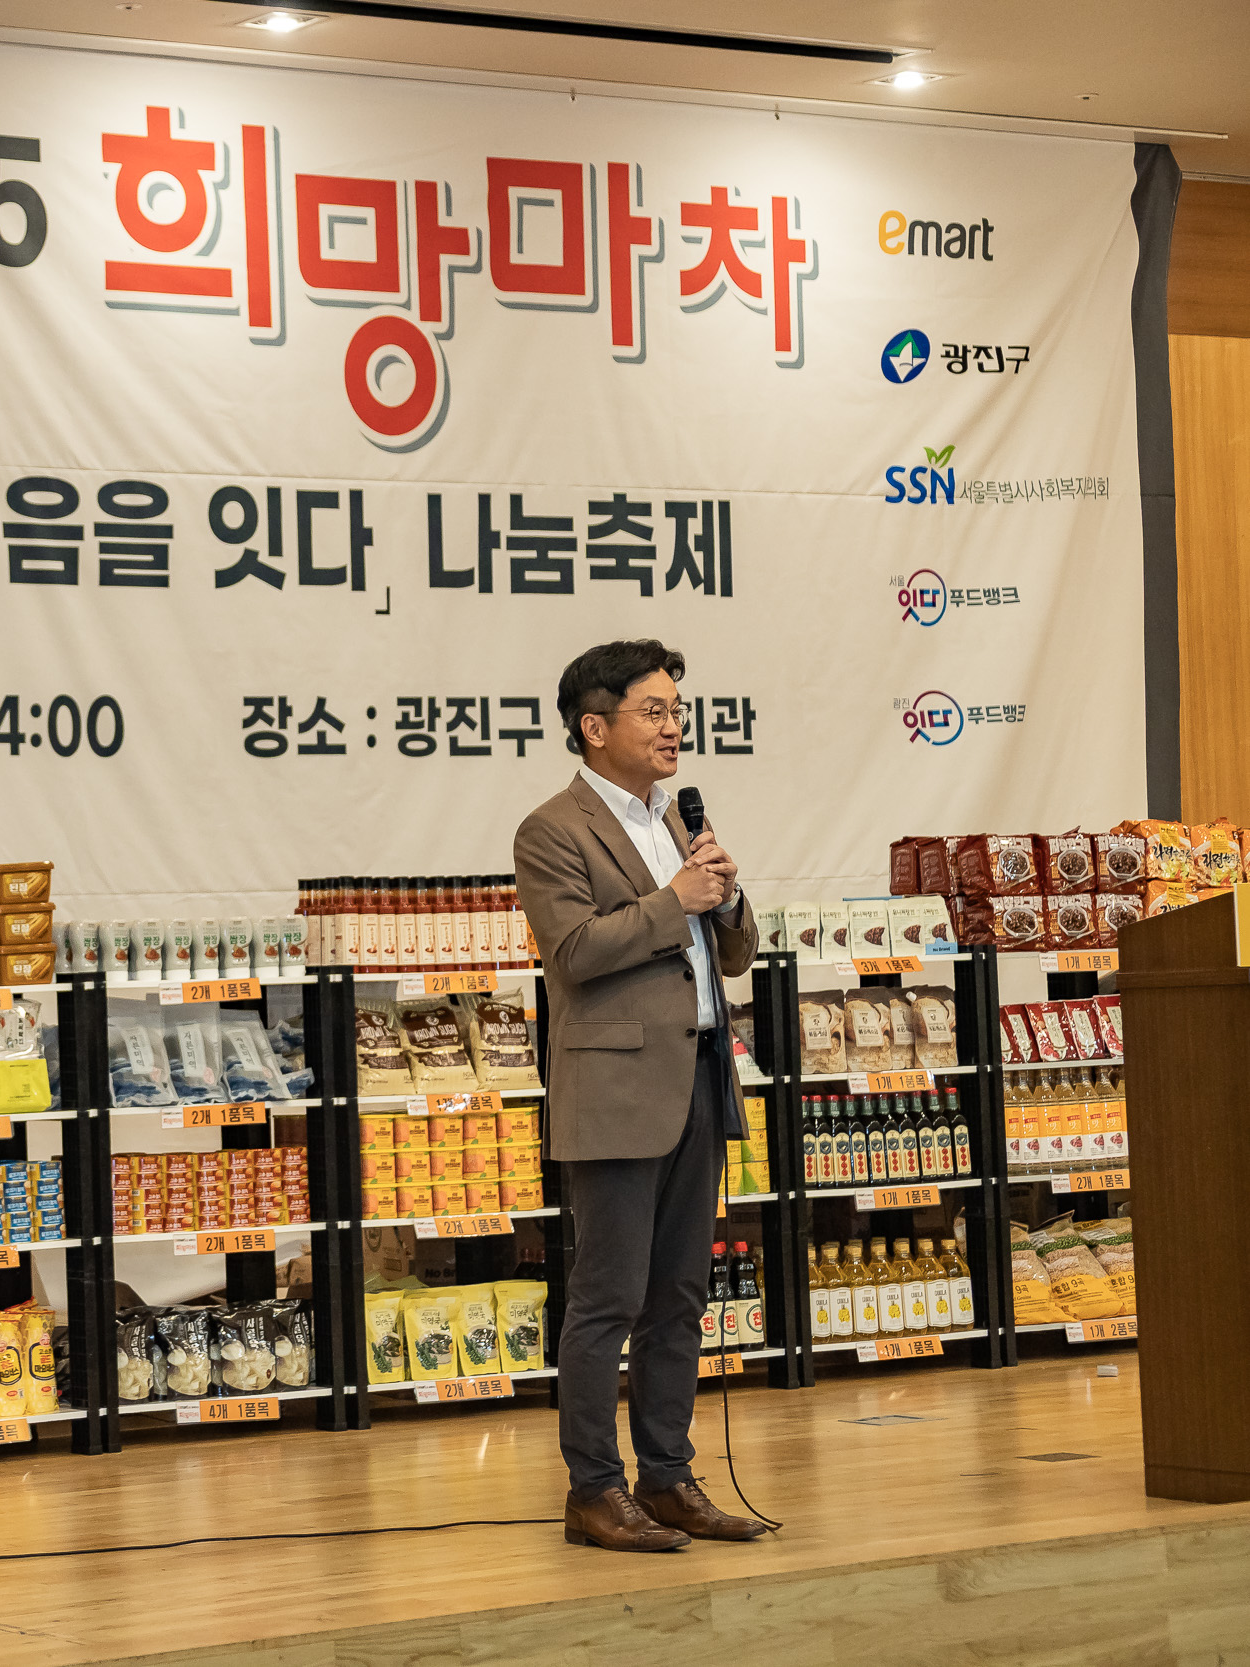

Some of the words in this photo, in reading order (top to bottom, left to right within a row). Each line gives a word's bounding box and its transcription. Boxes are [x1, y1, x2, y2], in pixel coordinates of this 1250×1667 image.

[879, 210, 994, 262] emart
[101, 104, 815, 450] 희망마차
[940, 342, 1030, 375] 광진구
[885, 465, 956, 504] SSN
[427, 492, 734, 598] 나눔축제
[950, 586, 1020, 607] 푸드뱅크
[242, 696, 347, 758] 장소
[395, 696, 544, 757] 광진구
[861, 959, 879, 973] 3개
[887, 957, 913, 971] 1품목
[1065, 957, 1080, 969] 1개
[1087, 955, 1111, 967] 1품목
[192, 986, 210, 999] 2개
[221, 983, 250, 997] 1품목
[433, 978, 450, 992] 2개
[460, 975, 489, 990] 1품목
[876, 1077, 892, 1090] 1개
[899, 1075, 925, 1088] 1품목
[192, 1110, 210, 1124] 2개
[222, 1107, 254, 1122] 1품목
[1077, 1177, 1091, 1189] 2개
[1100, 1175, 1123, 1187] 1품목
[882, 1192, 897, 1205] 1개
[906, 1190, 931, 1203] 1품목
[444, 1221, 463, 1235] 2개
[471, 1218, 502, 1233] 1품목
[206, 1237, 224, 1251] 2개
[235, 1235, 265, 1249] 1품목
[1091, 1325, 1103, 1337] 1개
[1111, 1322, 1136, 1335] 2품목
[885, 1344, 901, 1356] 1개
[909, 1341, 934, 1354] 1품목
[445, 1384, 464, 1398] 2개
[472, 1380, 502, 1396] 1품목
[210, 1404, 227, 1418] 4개
[238, 1402, 268, 1417] 1품목
